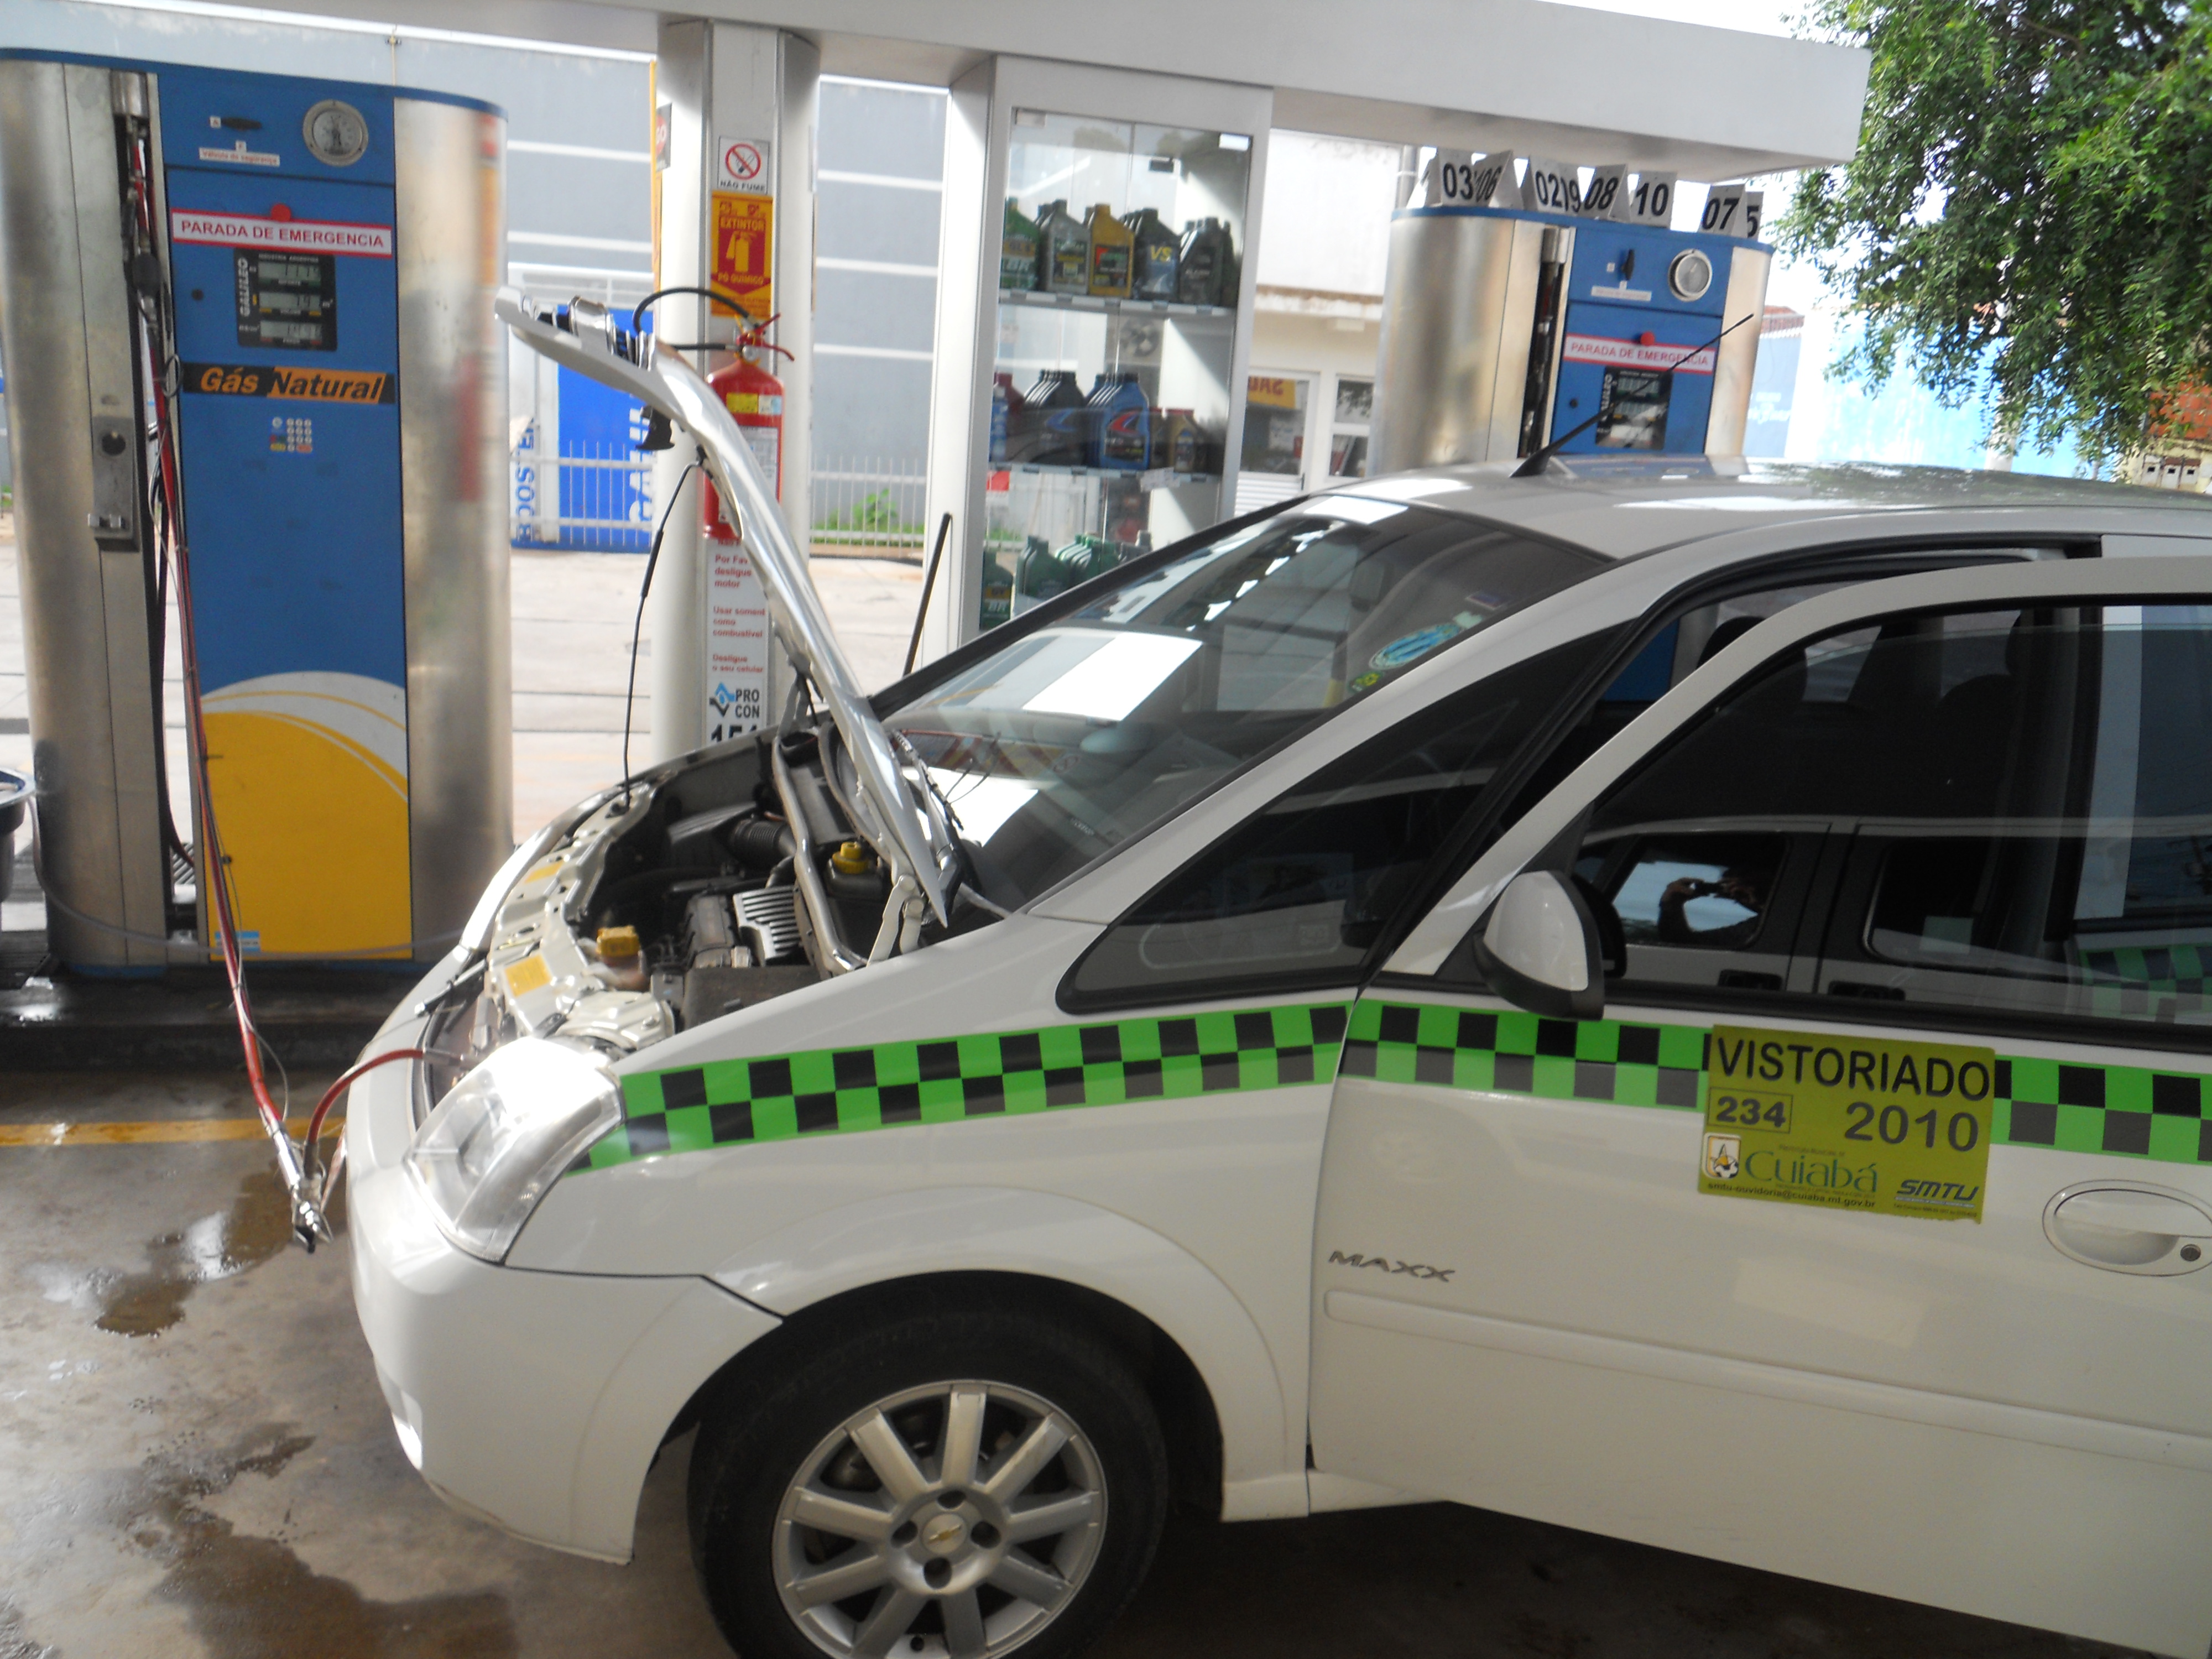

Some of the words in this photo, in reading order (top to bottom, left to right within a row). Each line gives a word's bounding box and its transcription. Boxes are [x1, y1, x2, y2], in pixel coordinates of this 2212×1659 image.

[1443, 163, 1473, 200] 03
[1535, 170, 1562, 207] 02
[1584, 177, 1619, 211] 08
[1635, 182, 1669, 216] 10
[1702, 197, 1740, 230] 07
[182, 220, 248, 238] PARADA
[253, 226, 274, 239] DE
[279, 229, 384, 248] EMERGENCIA
[1571, 343, 1616, 356] PARADA
[1619, 349, 1634, 359] DE
[200, 367, 259, 394] Gás
[270, 369, 383, 400] Natural
[715, 554, 729, 563] Por
[715, 566, 752, 578] desligue
[714, 580, 740, 588] motor
[713, 606, 732, 614] Usar
[713, 654, 747, 664] Desligue
[735, 689, 759, 702] PRO
[735, 705, 759, 718] CON
[1718, 1037, 1990, 1101] VISTORIADO
[1716, 1096, 1786, 1128] 234
[1845, 1102, 1979, 1151] 2010
[1745, 1150, 1877, 1192] Cuiabá
[1897, 1179, 1979, 1201] SMTU
[1328, 1251, 1455, 1282] MAXX
